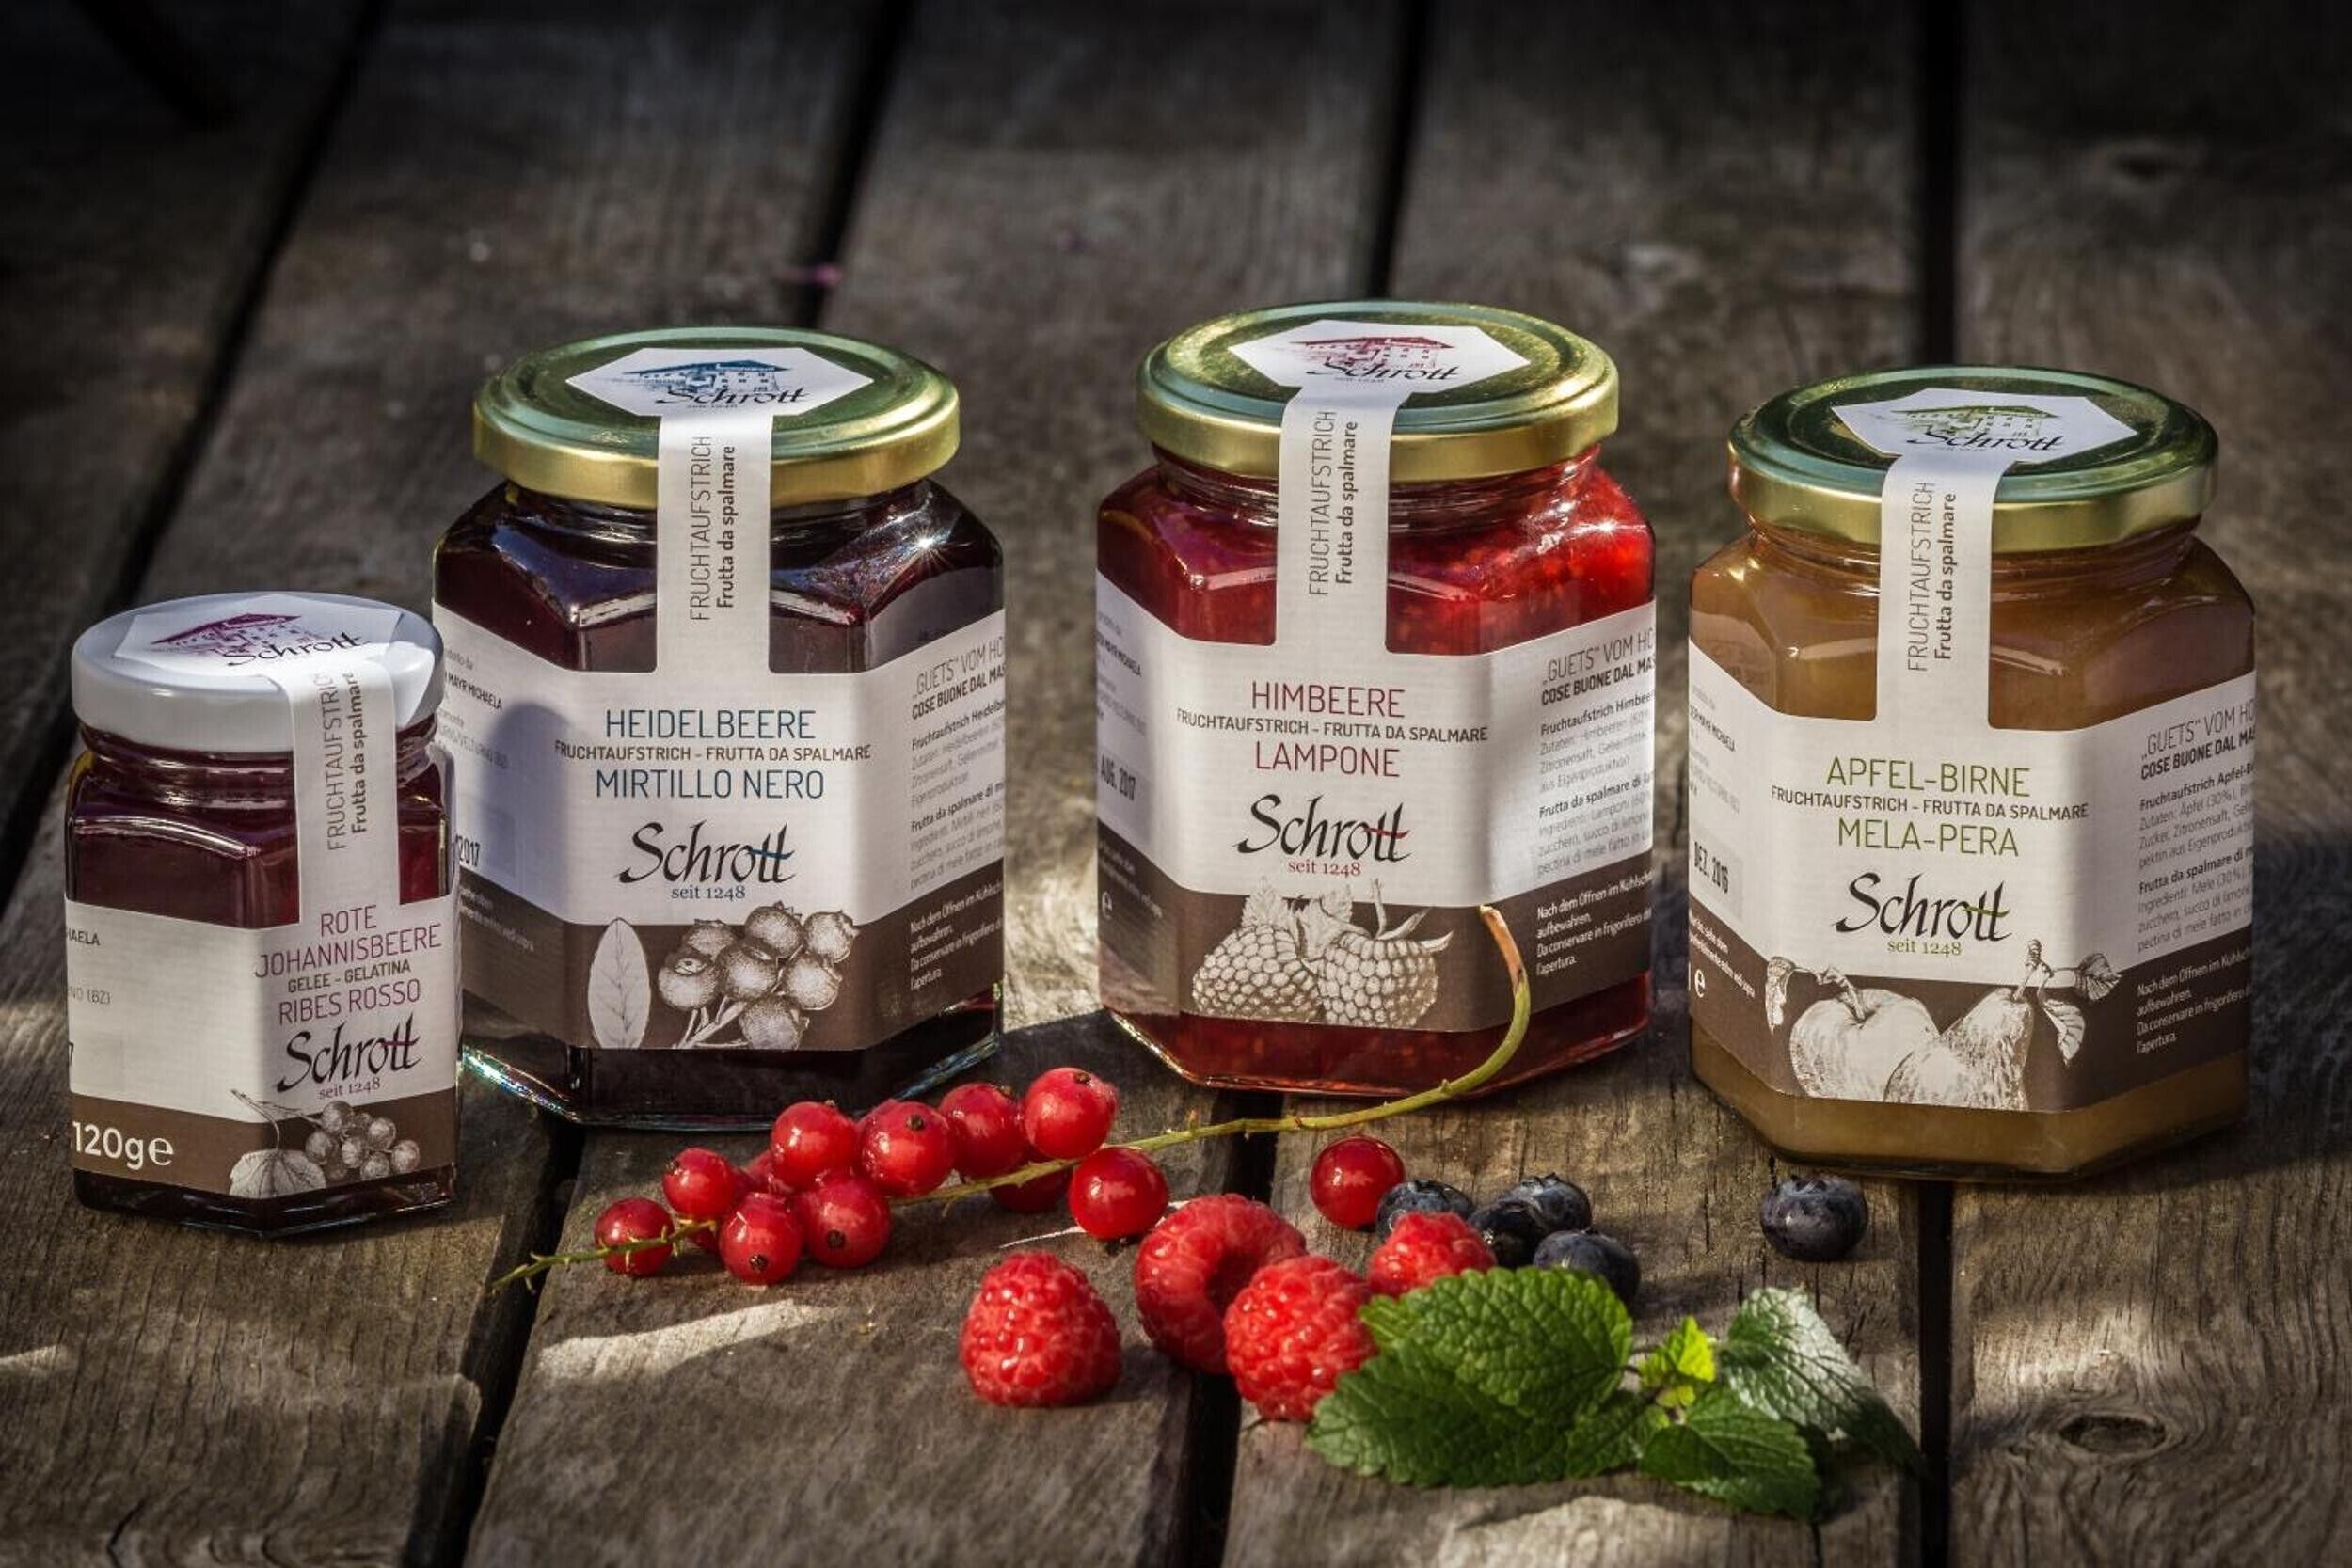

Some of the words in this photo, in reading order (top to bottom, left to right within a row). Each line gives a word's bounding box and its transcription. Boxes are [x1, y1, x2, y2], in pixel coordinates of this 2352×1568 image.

[655, 385, 811, 404] Schrott
[1907, 425, 2063, 451] Schrott
[1337, 421, 1359, 502] spalmare
[717, 446, 739, 527] spalmare
[1309, 411, 1337, 596] FRUCHTAUFSTRICH
[690, 436, 712, 622] FRUCHTAUFSTRICH
[1337, 505, 1354, 528] da
[1937, 493, 1958, 576] spalmare
[716, 529, 735, 552] da
[1336, 531, 1354, 584] Frutta
[716, 555, 735, 609] Frutta
[1908, 482, 1935, 672] FRUCHTAUFSTRICH
[1936, 579, 1953, 602] da
[227, 632, 373, 667] Schrott
[1603, 633, 1633, 665] VOM
[1934, 605, 1952, 660] Frutta
[961, 644, 985, 674] VOM
[912, 694, 935, 721] COSE
[937, 678, 968, 708] BUONE
[969, 670, 986, 692] DAL
[1251, 680, 1406, 718] HIMBEERE
[1541, 681, 1571, 707] COSE
[1573, 668, 1611, 696] BUONE
[1613, 660, 1634, 683] DAL
[606, 709, 817, 739] HEIDELBEERE
[1176, 707, 1309, 735] FRUCHTAUFSTRICH
[1324, 721, 1381, 739] FRUTTA
[1385, 724, 1406, 740] DA
[1409, 726, 1489, 743] SPALMARE
[1540, 701, 1613, 737] Fruchtaufstrich
[2203, 706, 2234, 736] VOM
[349, 752, 365, 776] da
[554, 739, 691, 761] FRUCHTAUFSTRICH
[707, 746, 765, 761] FRUTTA
[769, 746, 789, 761] DA
[792, 744, 871, 763] SPALMARE
[1256, 740, 1401, 778] LAMPONE
[2140, 754, 2170, 781] COSE
[2172, 740, 2213, 769] BUONE
[2215, 732, 2236, 755] DAL
[596, 768, 732, 799] MIRTILLO
[742, 768, 825, 799] NERO
[1827, 756, 2031, 798] APFEL-BIRNE
[2139, 776, 2214, 812] Fruchtaufstrich
[351, 777, 368, 835] Frutta
[1539, 797, 1568, 819] Frutta
[1571, 791, 1583, 809] da
[1586, 777, 1629, 807] spalmare
[1771, 784, 1908, 812] FRUCHTAUFSTRICH
[1923, 799, 1981, 817] FRUTTA
[1985, 802, 2007, 818] DA
[2010, 802, 2089, 821] SPALMARE
[1232, 791, 1411, 863] Schrott
[1837, 816, 2019, 857] MELA-PERA
[615, 819, 797, 884] Schrott
[1287, 859, 1317, 875] seit
[1322, 861, 1362, 878] 1248
[2139, 872, 2169, 895] Frutta
[2170, 867, 2183, 884] da
[2186, 850, 2232, 881] spalmare
[2233, 846, 2243, 863] di
[671, 885, 701, 899] seit
[707, 884, 746, 900] 1248
[1831, 871, 2012, 942] Schrott
[321, 905, 376, 937] ROTE
[255, 923, 442, 979] JOHANNISBEERE
[1887, 940, 1916, 954] seit
[1922, 941, 1962, 958] 1248
[288, 972, 331, 993] GELEE
[344, 958, 411, 984] GELATINA
[278, 992, 342, 1026] RIBES
[349, 978, 421, 1013] ROSSO
[277, 1012, 422, 1092] Schrott
[319, 1085, 344, 1100] seit
[348, 1076, 381, 1099] 1248
